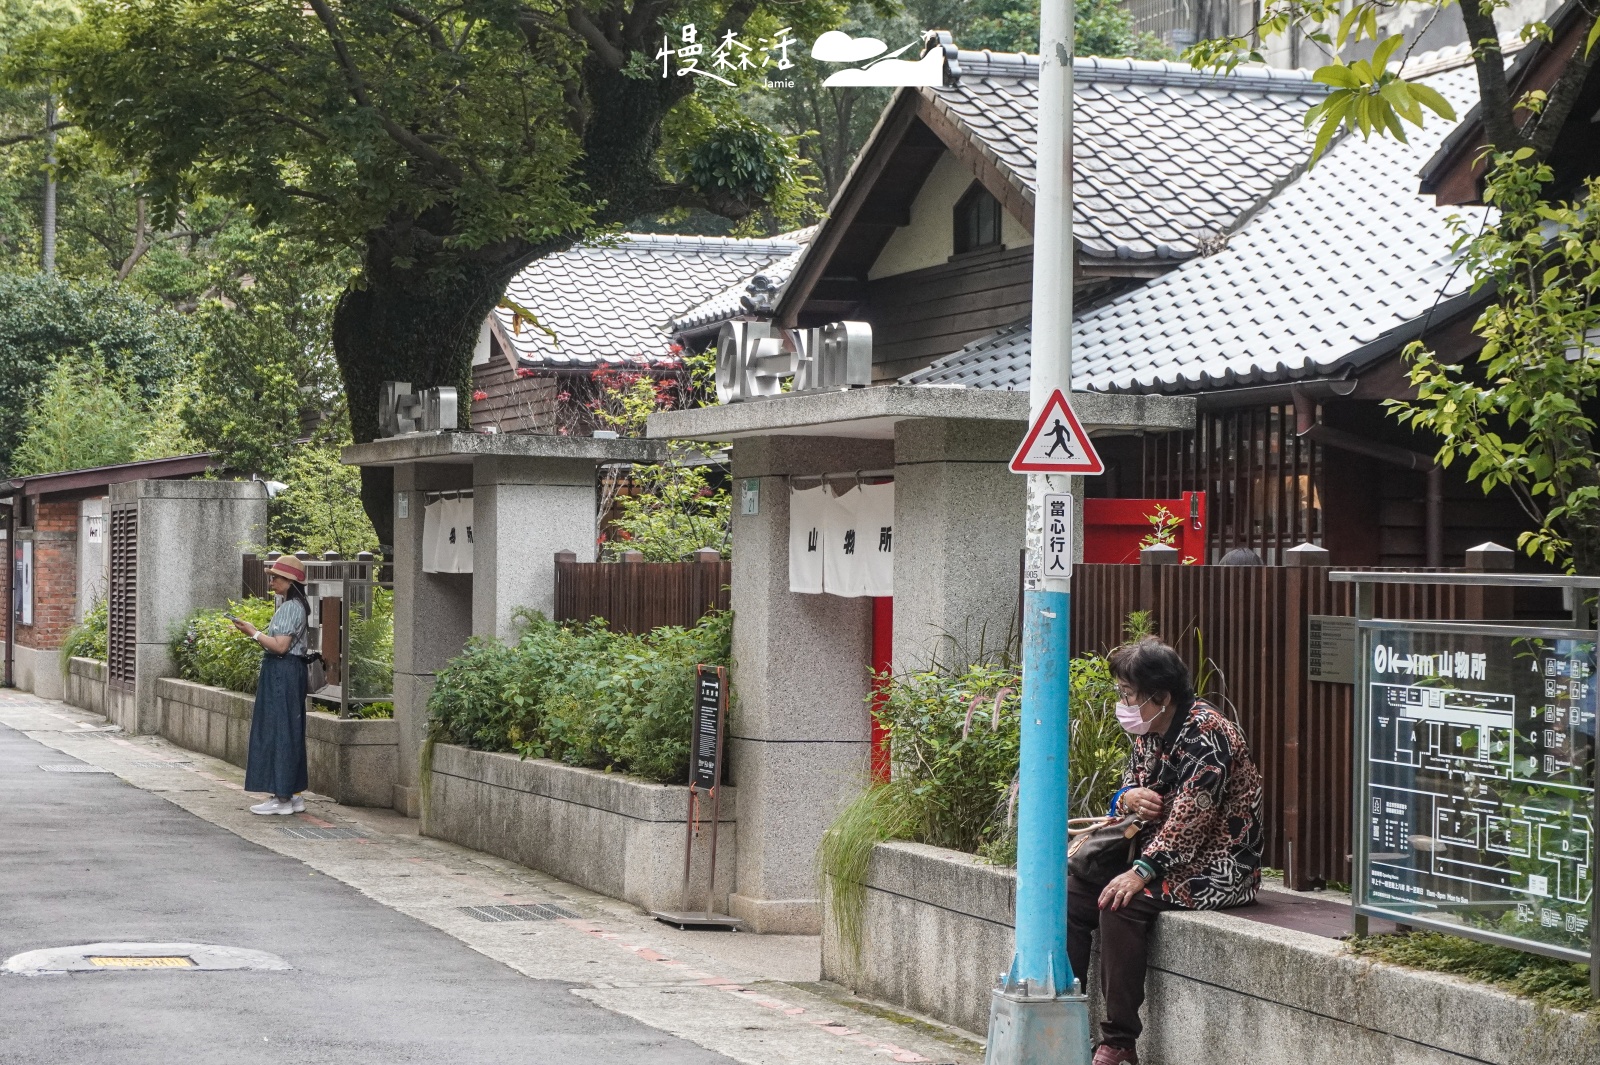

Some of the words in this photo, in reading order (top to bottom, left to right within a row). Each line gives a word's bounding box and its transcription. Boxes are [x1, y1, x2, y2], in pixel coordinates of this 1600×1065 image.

[807, 526, 892, 555] 山物所
[1049, 500, 1066, 571] 當心行人
[1438, 650, 1487, 681] 山物所
[1531, 660, 1538, 673] A
[1530, 706, 1537, 718] B
[1410, 730, 1417, 742] A
[1456, 735, 1462, 747] B
[1530, 731, 1537, 743] C
[1496, 740, 1503, 752] C
[1529, 756, 1537, 768] D
[1454, 821, 1461, 834] F
[1505, 830, 1512, 842] E
[1562, 839, 1569, 852] D
